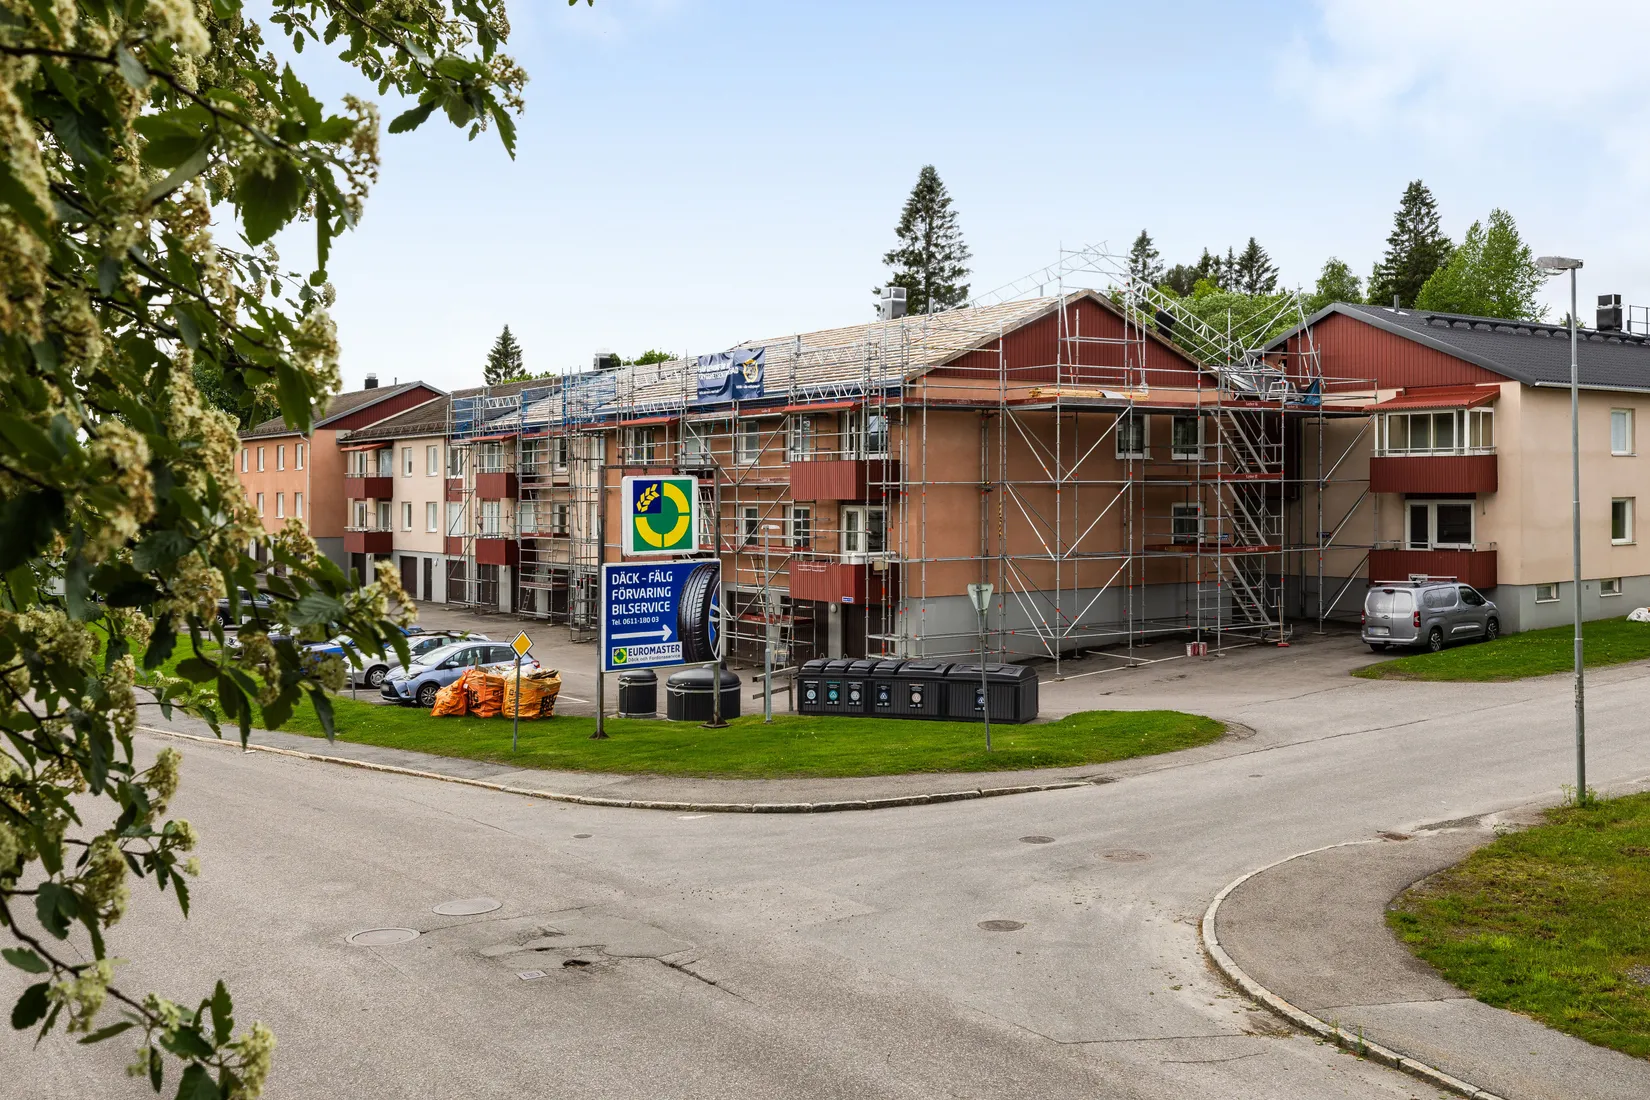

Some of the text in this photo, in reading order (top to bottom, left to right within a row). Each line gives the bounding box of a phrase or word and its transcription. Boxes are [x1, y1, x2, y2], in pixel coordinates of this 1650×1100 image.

[612, 572, 640, 584] DÄCK
[648, 570, 672, 583] FÄLG
[612, 587, 671, 600] FÖRVARING
[612, 601, 670, 615] BILSERVICE
[628, 644, 680, 656] EUROMASTER
